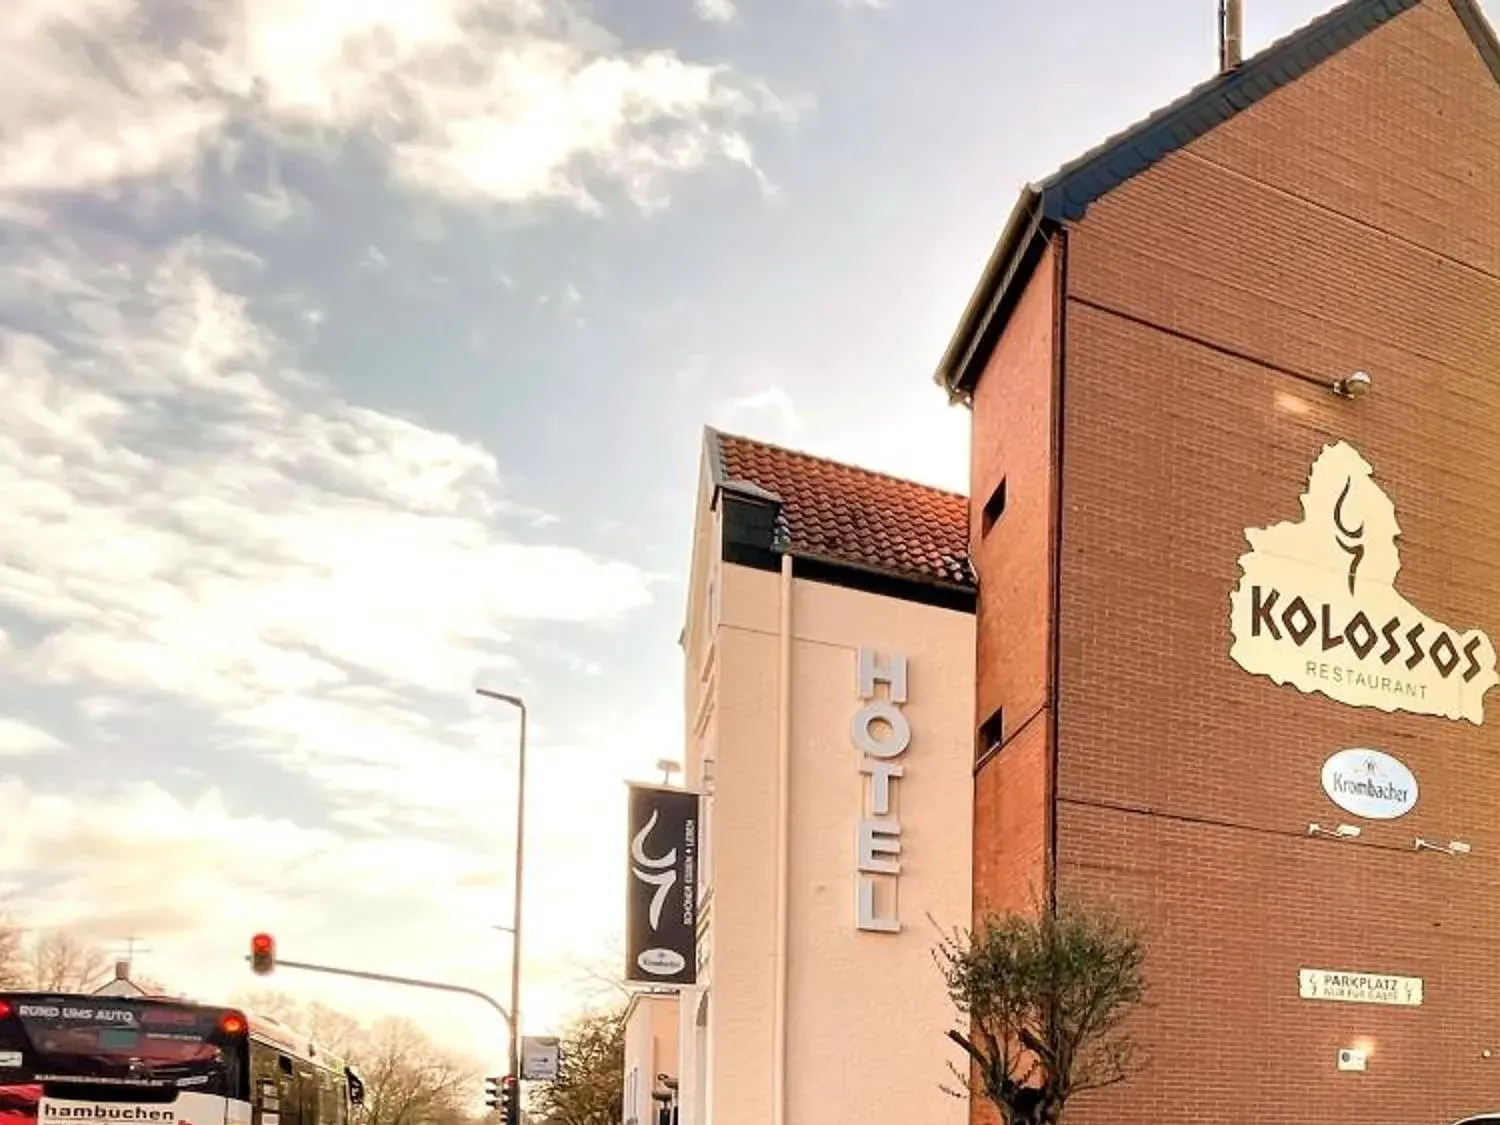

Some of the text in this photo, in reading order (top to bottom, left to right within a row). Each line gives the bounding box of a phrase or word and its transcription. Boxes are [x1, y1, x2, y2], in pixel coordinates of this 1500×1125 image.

[1251, 585, 1483, 683] KOLOSSOS
[1305, 660, 1428, 699] RESTAURANT
[852, 646, 912, 935] HOTEL
[1333, 771, 1408, 802] Krombacher
[1324, 974, 1397, 990] PARKPLATZ
[19, 1005, 133, 1022] RUND UMS AUTO
